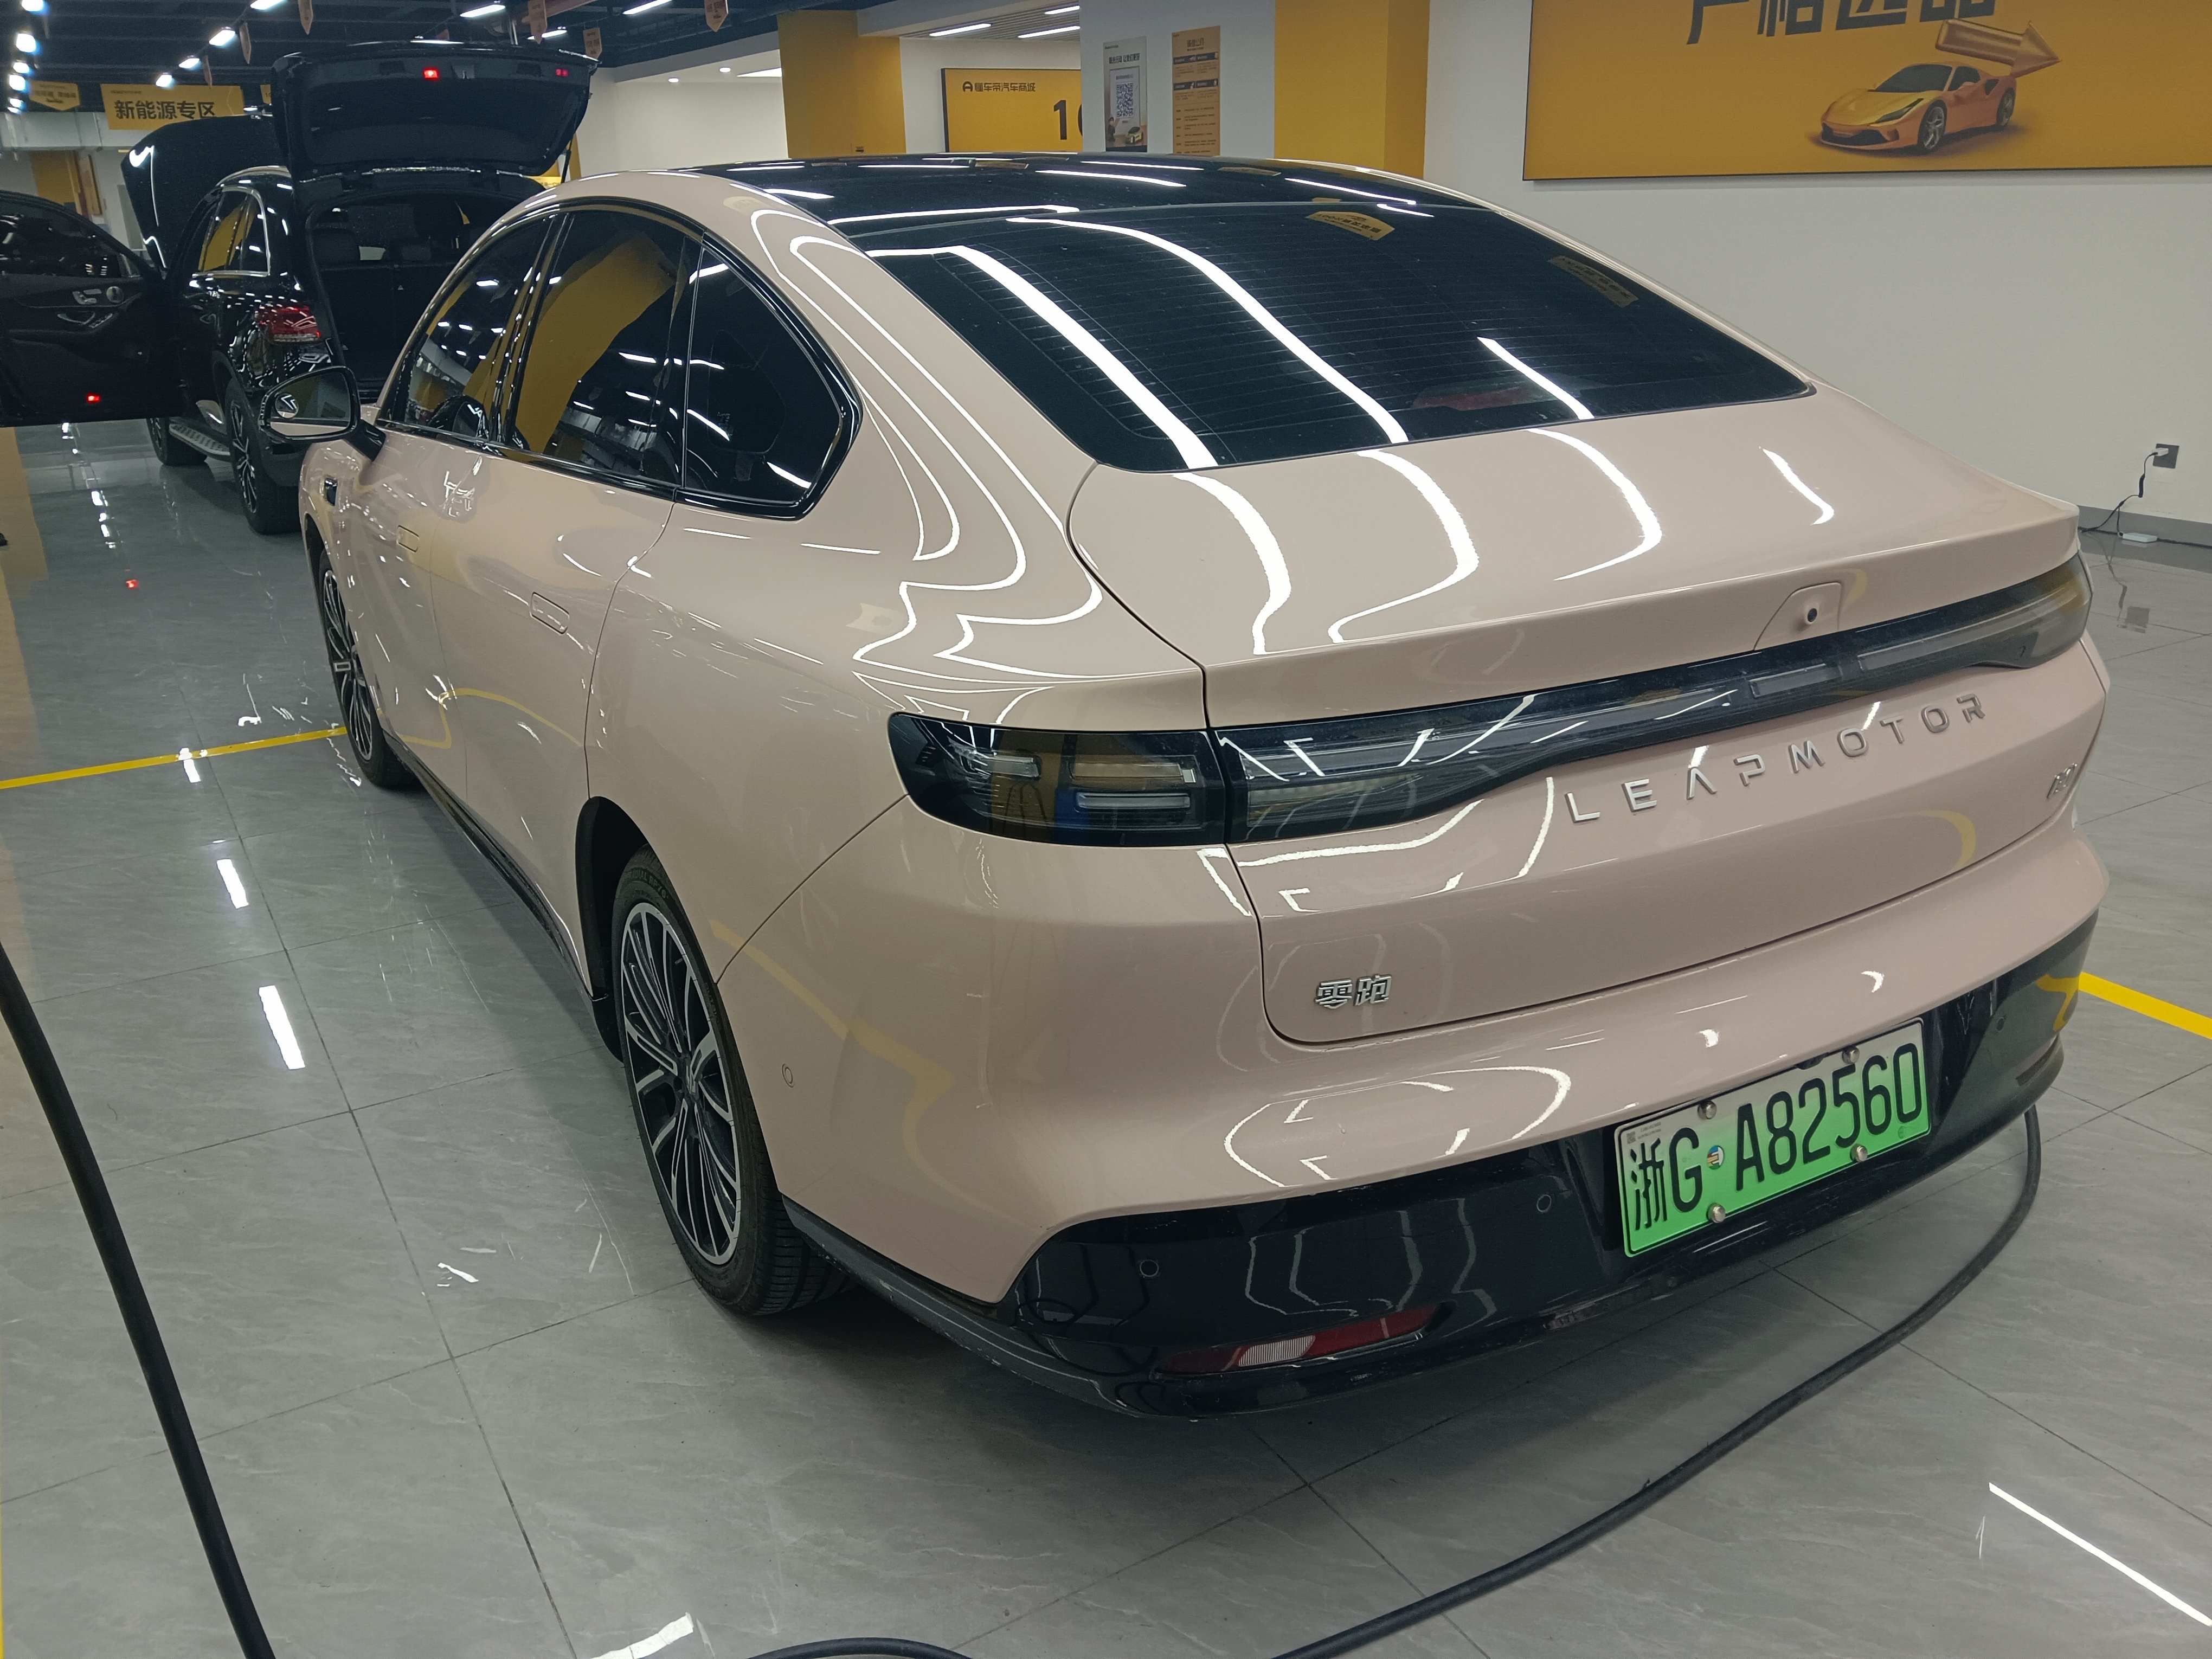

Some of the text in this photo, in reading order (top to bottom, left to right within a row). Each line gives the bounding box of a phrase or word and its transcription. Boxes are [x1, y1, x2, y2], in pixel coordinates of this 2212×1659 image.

[114, 100, 217, 120] 新能源专区
[1053, 100, 1083, 140] 1
[1565, 692, 1985, 823] LEAPMOTOR
[1314, 973, 1392, 1009] 零跑
